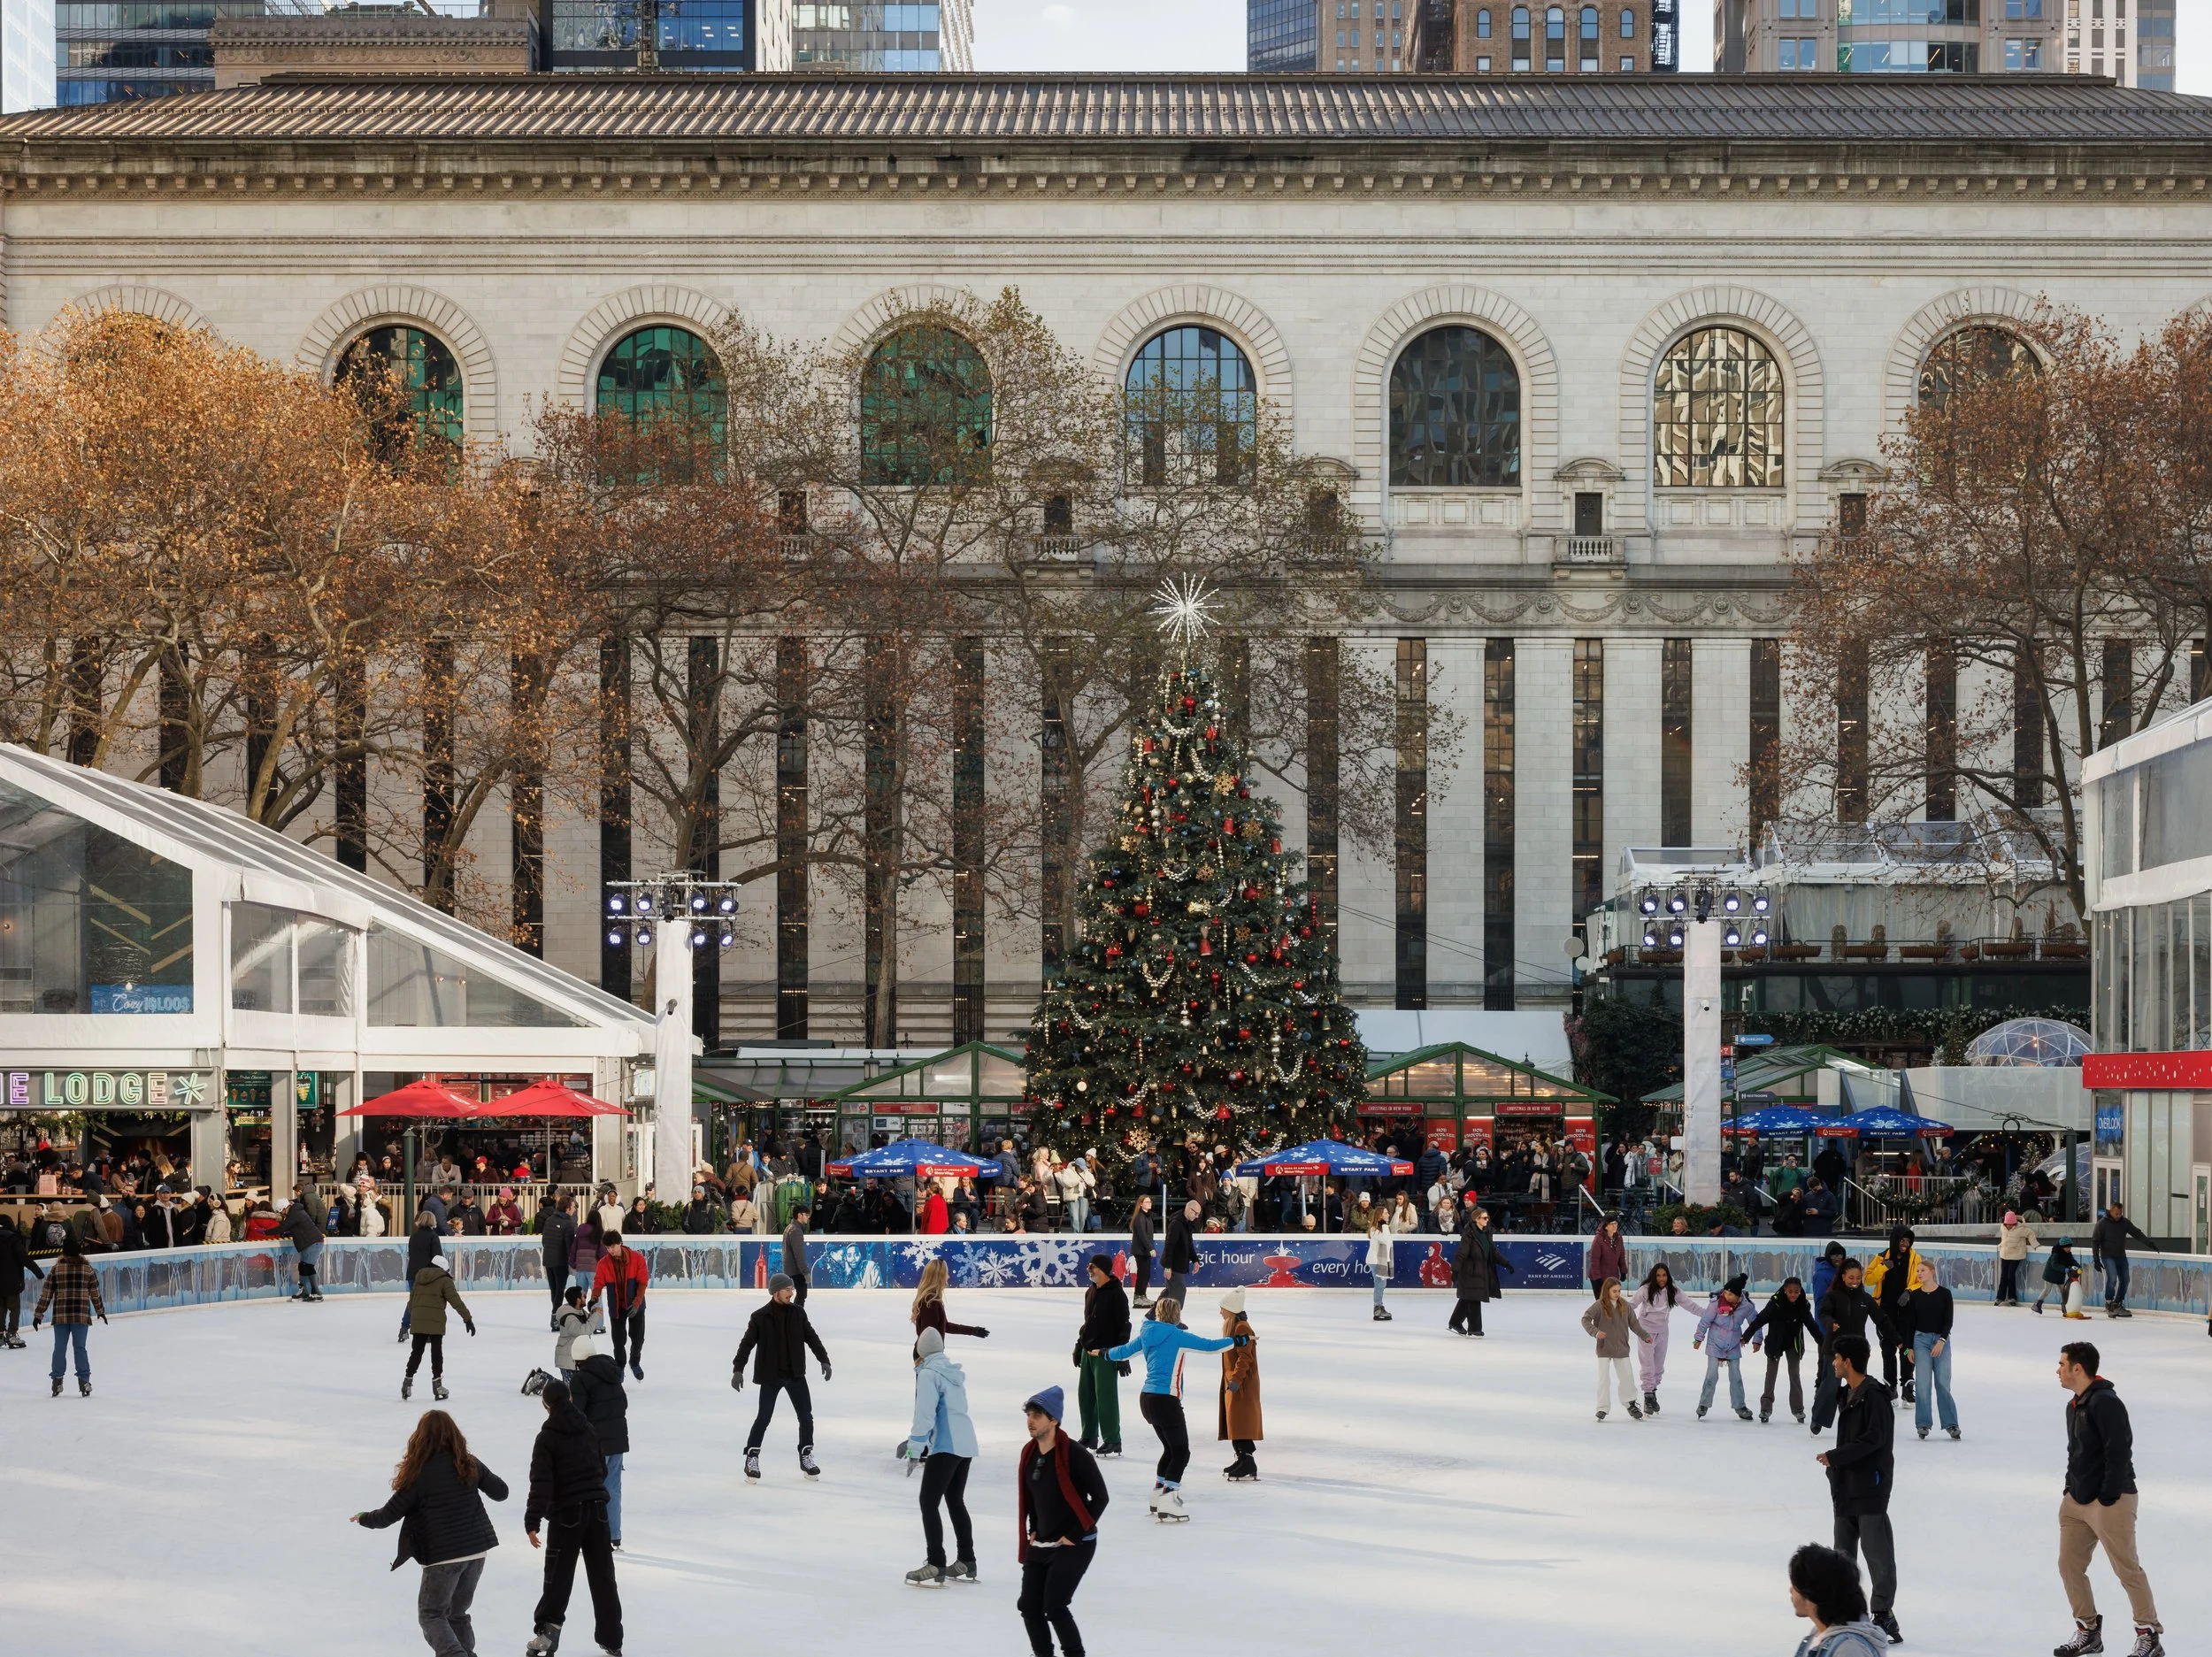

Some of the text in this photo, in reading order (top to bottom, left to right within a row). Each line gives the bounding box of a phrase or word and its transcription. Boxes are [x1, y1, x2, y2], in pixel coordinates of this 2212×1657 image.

[112, 993, 190, 1013] Cozy IGLOOS
[0, 1072, 168, 1105] E LODGE
[2099, 1117, 2121, 1130] OVERLOOK
[1189, 1250, 1255, 1268] gic hour
[1312, 1259, 1371, 1277] every ho
